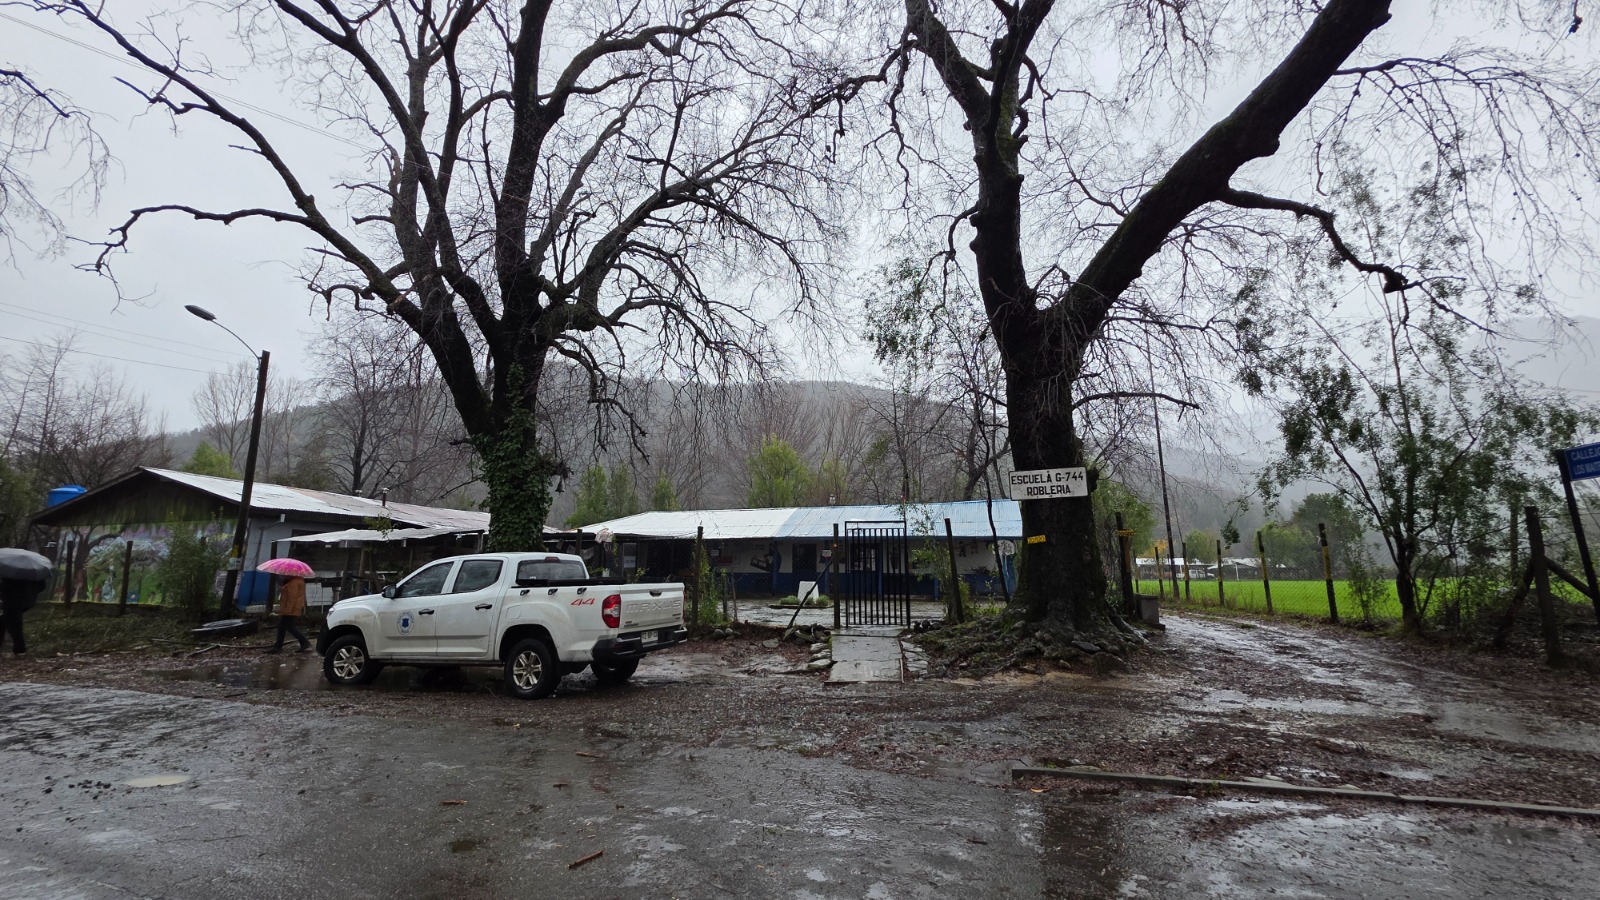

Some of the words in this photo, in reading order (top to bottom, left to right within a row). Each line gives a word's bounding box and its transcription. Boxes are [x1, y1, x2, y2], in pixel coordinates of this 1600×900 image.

[1011, 473, 1052, 485] ESCUELA
[1055, 472, 1084, 482] G-744
[1026, 484, 1071, 496] ROBLERIA
[626, 600, 681, 613] MAXUS
